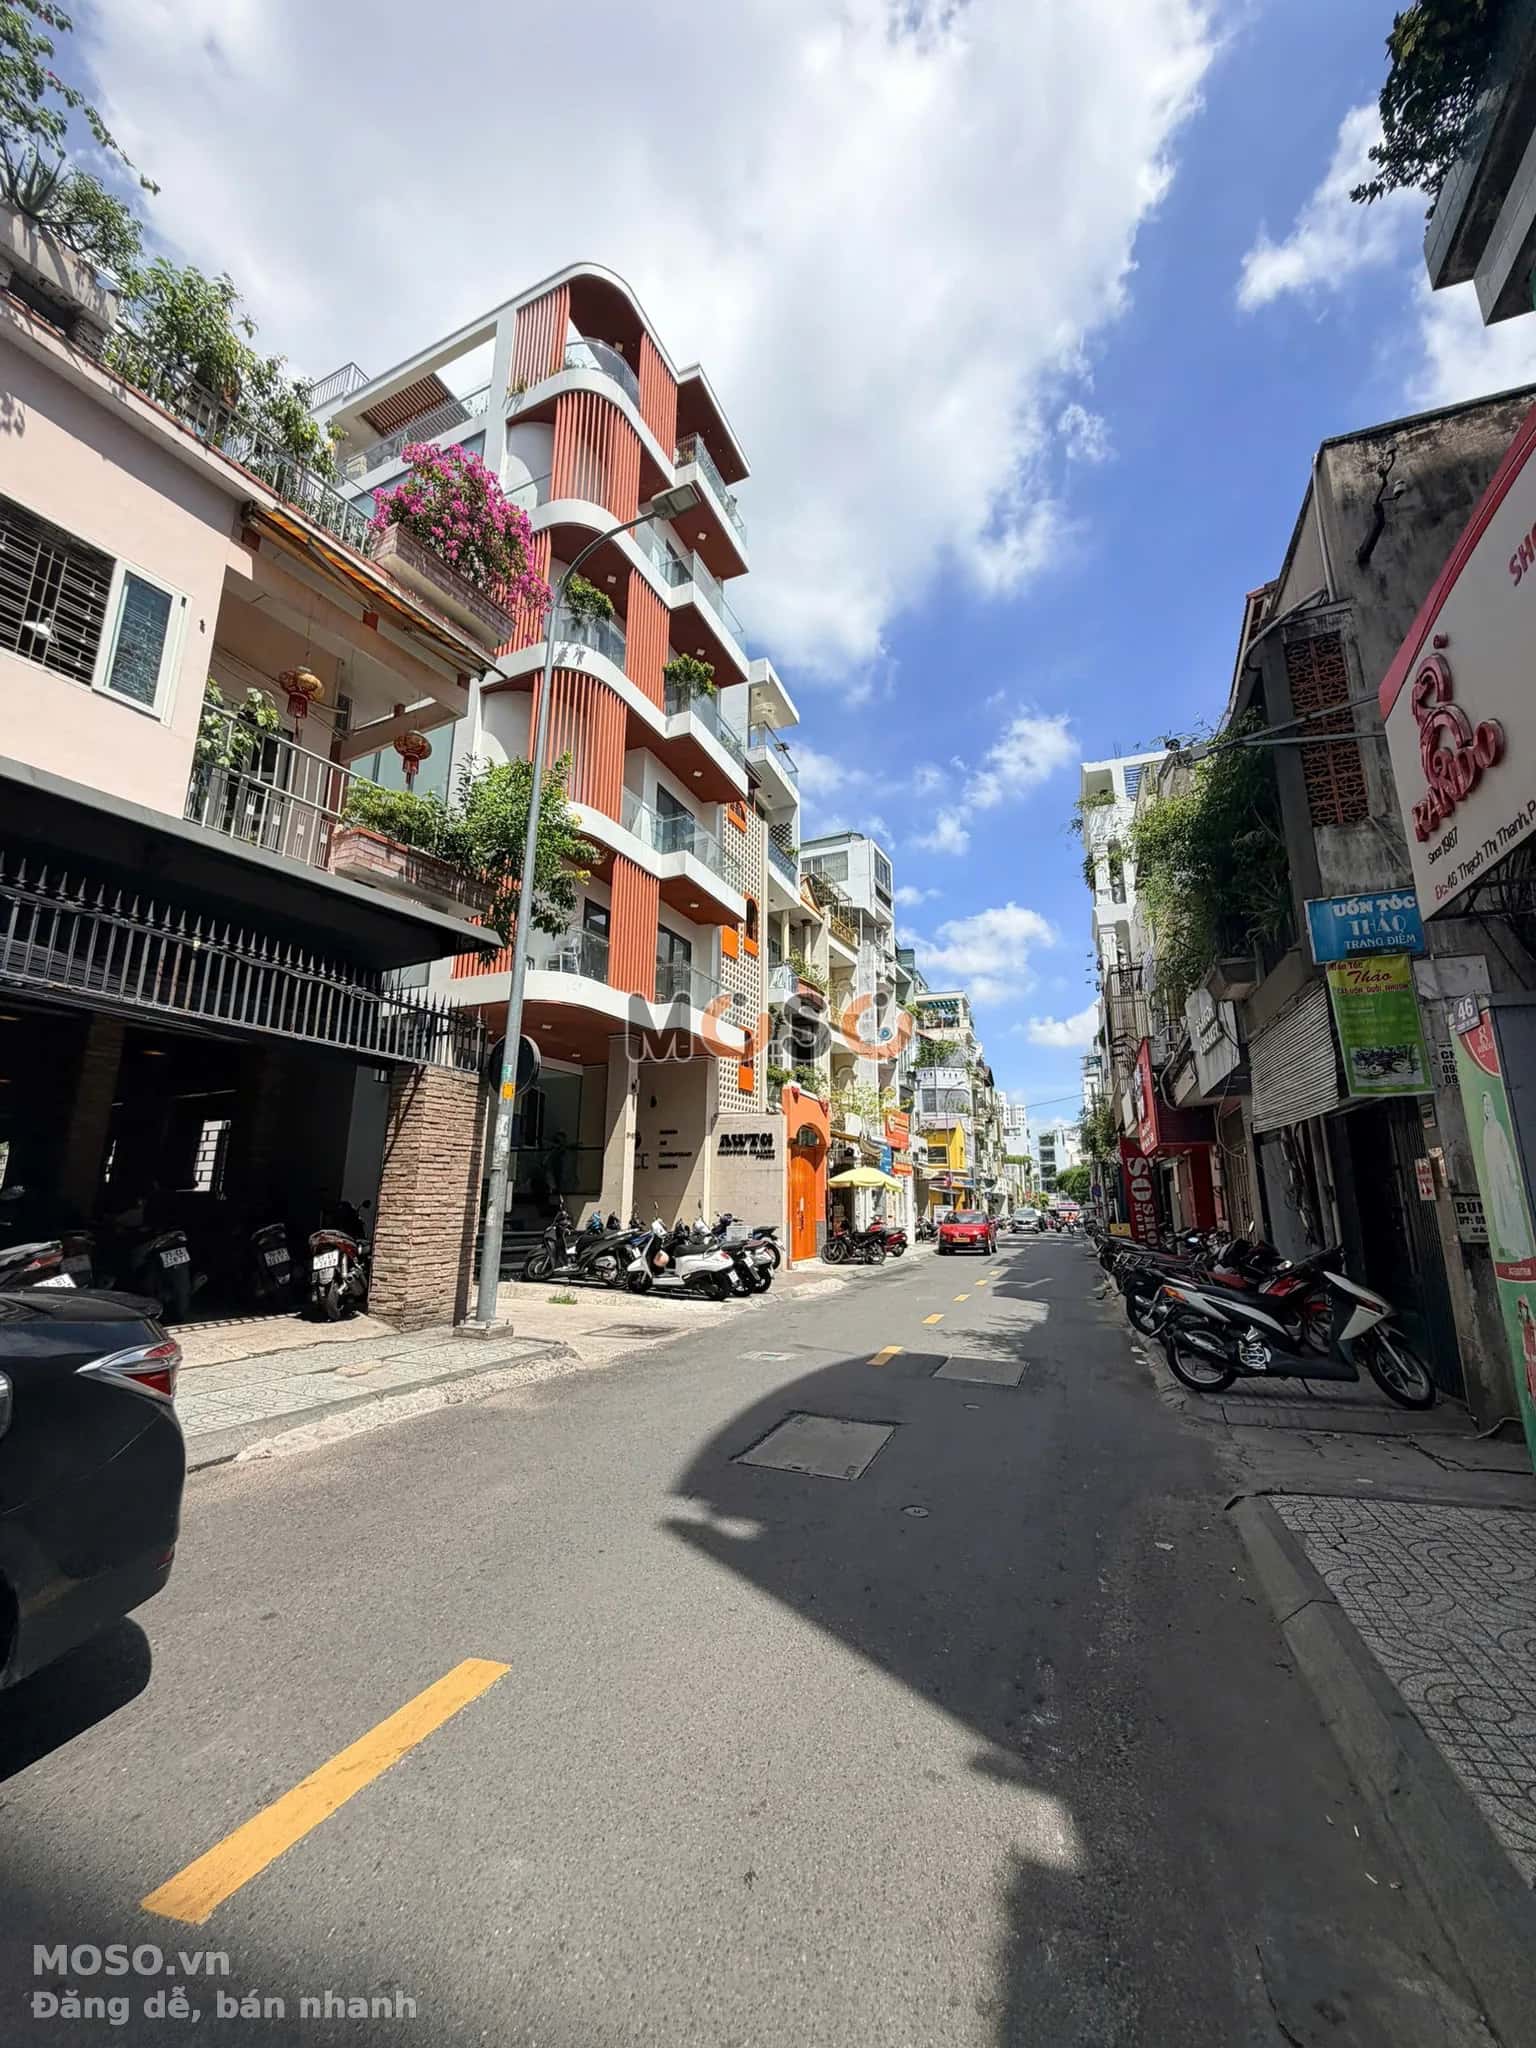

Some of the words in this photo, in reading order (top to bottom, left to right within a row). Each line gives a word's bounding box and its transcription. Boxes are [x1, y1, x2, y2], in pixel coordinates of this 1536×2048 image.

[1441, 826, 1458, 855] 1987
[1457, 850, 1484, 880] Thạch
[1481, 839, 1499, 858] Thị
[1333, 898, 1373, 917] UỐN
[1377, 894, 1416, 914] TÓC
[1349, 912, 1407, 936] THẢO
[1344, 938, 1384, 950] TRANG
[1346, 969, 1392, 985] Thảo
[1458, 998, 1473, 1020] 46
